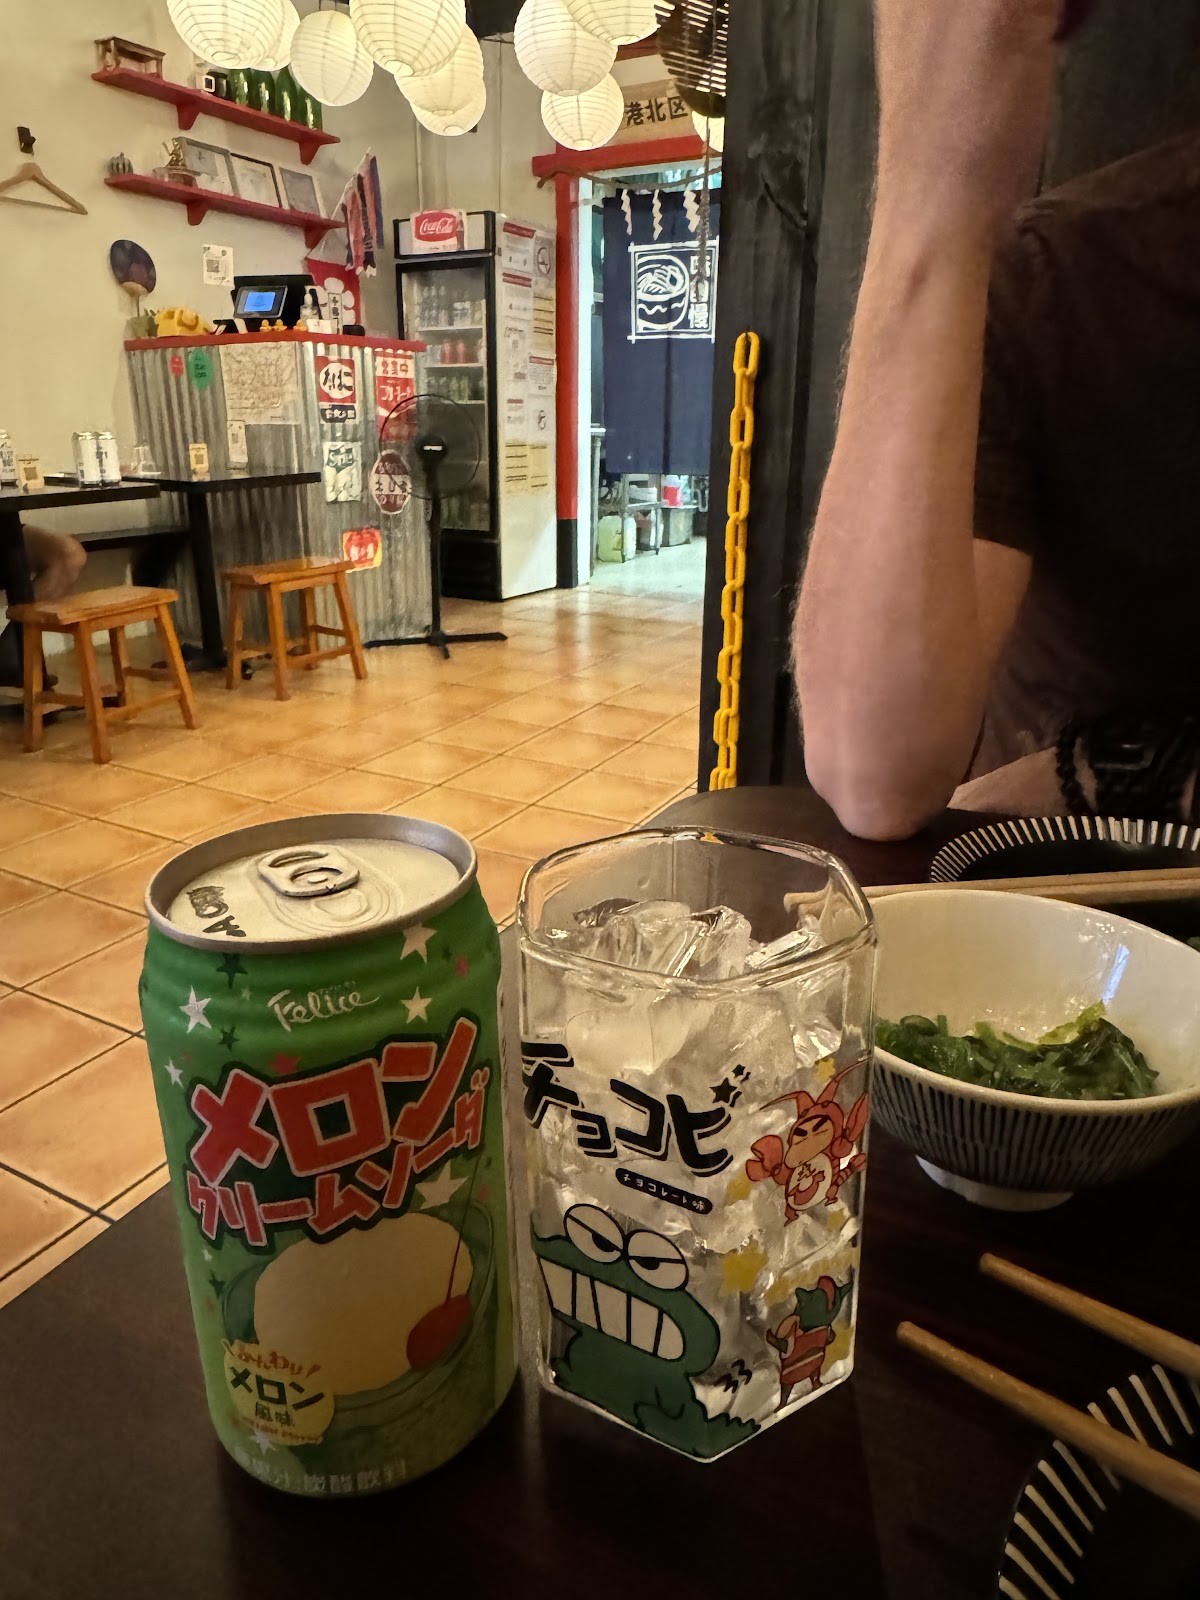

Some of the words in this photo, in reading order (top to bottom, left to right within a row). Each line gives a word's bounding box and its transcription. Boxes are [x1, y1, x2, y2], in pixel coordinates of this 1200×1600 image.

[625, 96, 688, 126] 港北区
[267, 989, 381, 1033] Felice
[191, 1017, 477, 1187] メロン
[521, 1041, 751, 1178] チョコビ
[187, 1067, 490, 1246] クリームソーダ
[623, 1173, 705, 1211] チョコレート味
[229, 1366, 325, 1411] メロン
